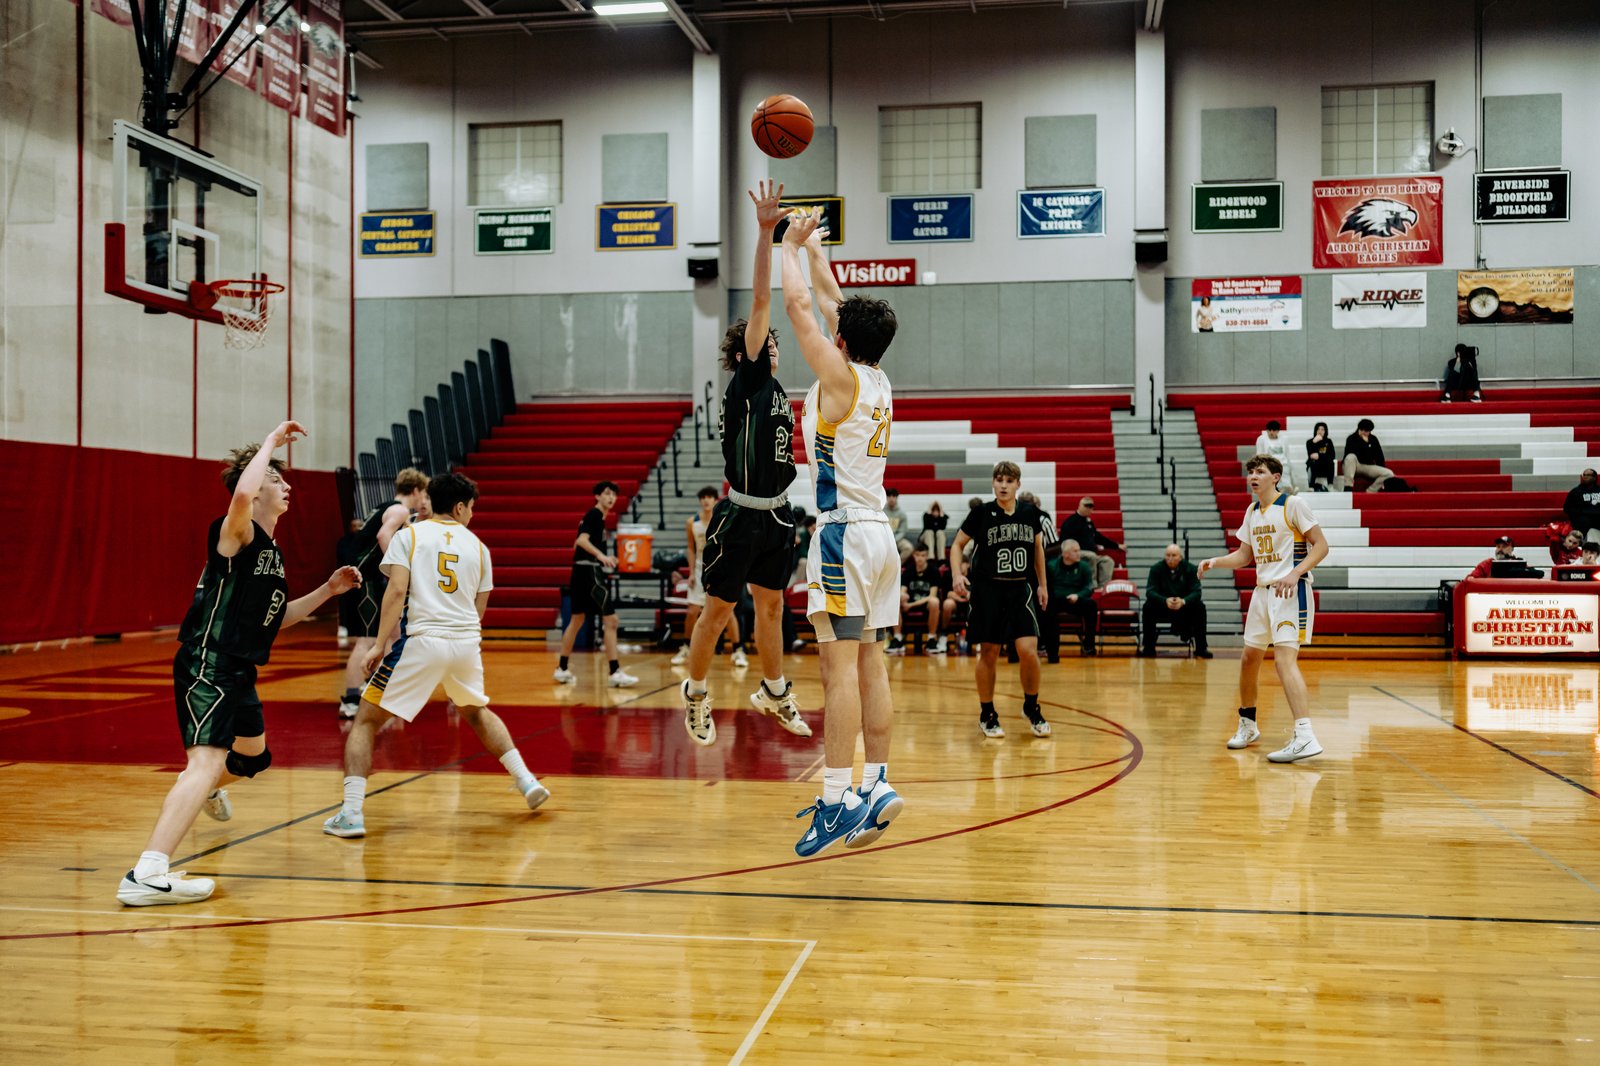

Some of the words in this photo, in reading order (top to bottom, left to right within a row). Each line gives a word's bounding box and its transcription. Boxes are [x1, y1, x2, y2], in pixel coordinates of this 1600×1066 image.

[1315, 186, 1360, 198] WELCOME
[1363, 185, 1375, 196] TO
[1377, 185, 1396, 195] THE
[1398, 184, 1426, 194] HOME
[1427, 183, 1441, 193] OF
[1493, 179, 1549, 190] RIVERSIDE
[1046, 195, 1091, 207] CATHOLIC
[1208, 196, 1267, 207] RIDGEWOOD
[1489, 191, 1553, 203] BROOKFIELD
[1048, 208, 1074, 218] PREP
[1218, 208, 1257, 220] REBELS
[1495, 204, 1547, 215] BULLDOGS
[917, 213, 943, 223] PREP
[913, 226, 948, 237] GATORS
[1040, 220, 1082, 231] KNIGHTS
[1326, 241, 1369, 254] AURORA
[1371, 240, 1430, 252] CHRISTIAN
[1357, 253, 1398, 264] EAGLES
[835, 262, 911, 284] Visitor
[1361, 288, 1423, 302] RIDGE
[1252, 524, 1276, 535] AURORA
[1256, 535, 1273, 555] 30
[997, 547, 1027, 574] 20
[437, 551, 459, 594] 5
[262, 588, 285, 627] 2
[1487, 607, 1578, 620] AURORA
[1472, 620, 1593, 634] CHRISTIAN
[1492, 634, 1573, 647] SCHOOL
